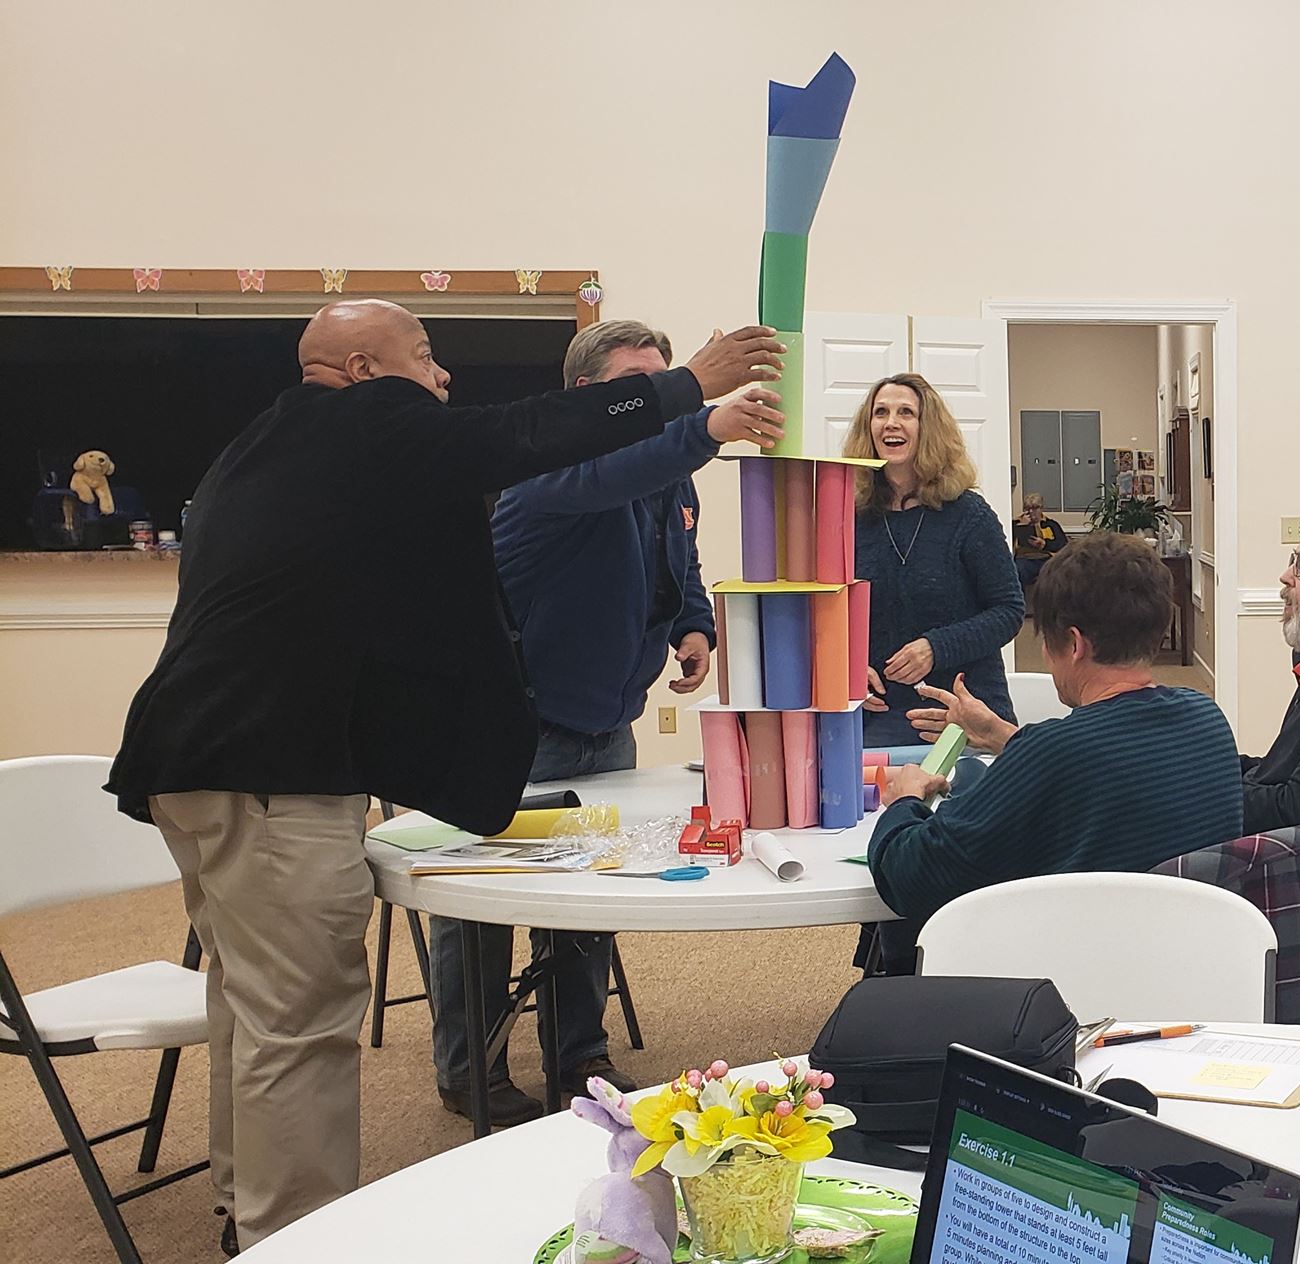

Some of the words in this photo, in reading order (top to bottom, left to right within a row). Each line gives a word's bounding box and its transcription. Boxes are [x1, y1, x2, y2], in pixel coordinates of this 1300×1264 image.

[958, 1132, 999, 1161] Exercise
[1000, 1150, 1016, 1167] 1.1
[954, 1182, 995, 1211] free-standing
[994, 1201, 1013, 1217] tower
[1013, 1209, 1027, 1224] that
[1027, 1217, 1050, 1234] stands
[1050, 1228, 1058, 1239] at
[1058, 1230, 1075, 1247] least
[1075, 1239, 1081, 1249] 5
[1082, 1241, 1096, 1258] feet
[1097, 1247, 1109, 1262] tall
[957, 1168, 974, 1184] Work
[974, 1178, 980, 1187] in
[981, 1181, 1003, 1197] groups
[1003, 1190, 1012, 1200] of
[1011, 1191, 1023, 1206] five
[1024, 1199, 1031, 1209] to
[1031, 1203, 1054, 1221] design
[1055, 1213, 1068, 1227] and
[1068, 1220, 1101, 1241] construct
[1101, 1235, 1107, 1244] a
[1163, 1201, 1195, 1222] Community
[950, 1213, 962, 1227] You
[962, 1219, 973, 1233] will
[973, 1224, 989, 1240] have
[989, 1235, 994, 1243] a
[994, 1236, 1009, 1250] total
[1009, 1244, 1017, 1255] of
[1018, 1247, 1027, 1259] 10
[952, 1196, 967, 1211] from
[967, 1204, 977, 1216] the
[977, 1209, 1000, 1227] bottom
[1000, 1220, 1008, 1231] of
[1008, 1223, 1019, 1236] the
[1019, 1230, 1048, 1250] structure
[1049, 1242, 1057, 1254] to
[1057, 1247, 1069, 1260] the
[1161, 1210, 1199, 1234] Preparedness
[1199, 1226, 1216, 1241] Roles
[943, 1243, 964, 1261] group.
[946, 1227, 952, 1238] 5
[952, 1232, 977, 1250] minutes
[976, 1243, 1004, 1264] planning
